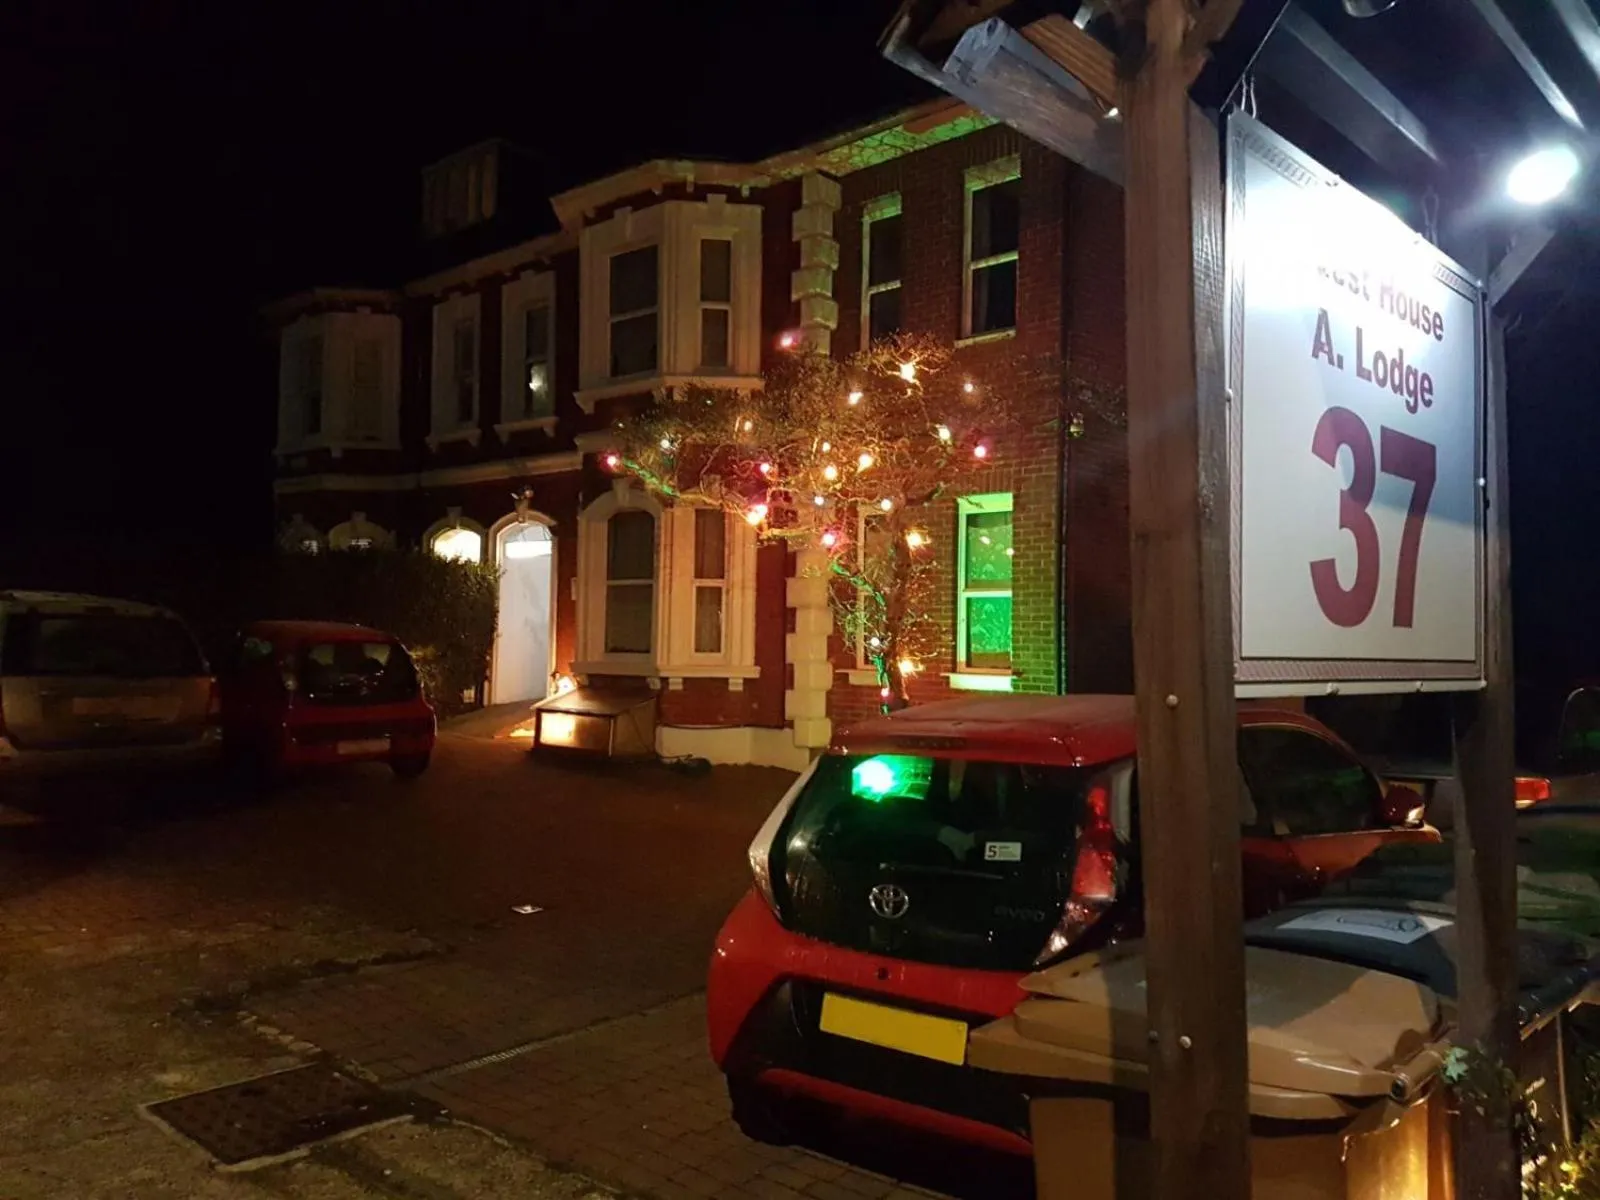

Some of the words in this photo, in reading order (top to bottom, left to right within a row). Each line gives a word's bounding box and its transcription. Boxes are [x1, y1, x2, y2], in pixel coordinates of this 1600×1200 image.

[1311, 307, 1344, 371] A.
[1356, 325, 1434, 415] Lodge
[1379, 276, 1444, 342] House
[1309, 406, 1437, 628] 37
